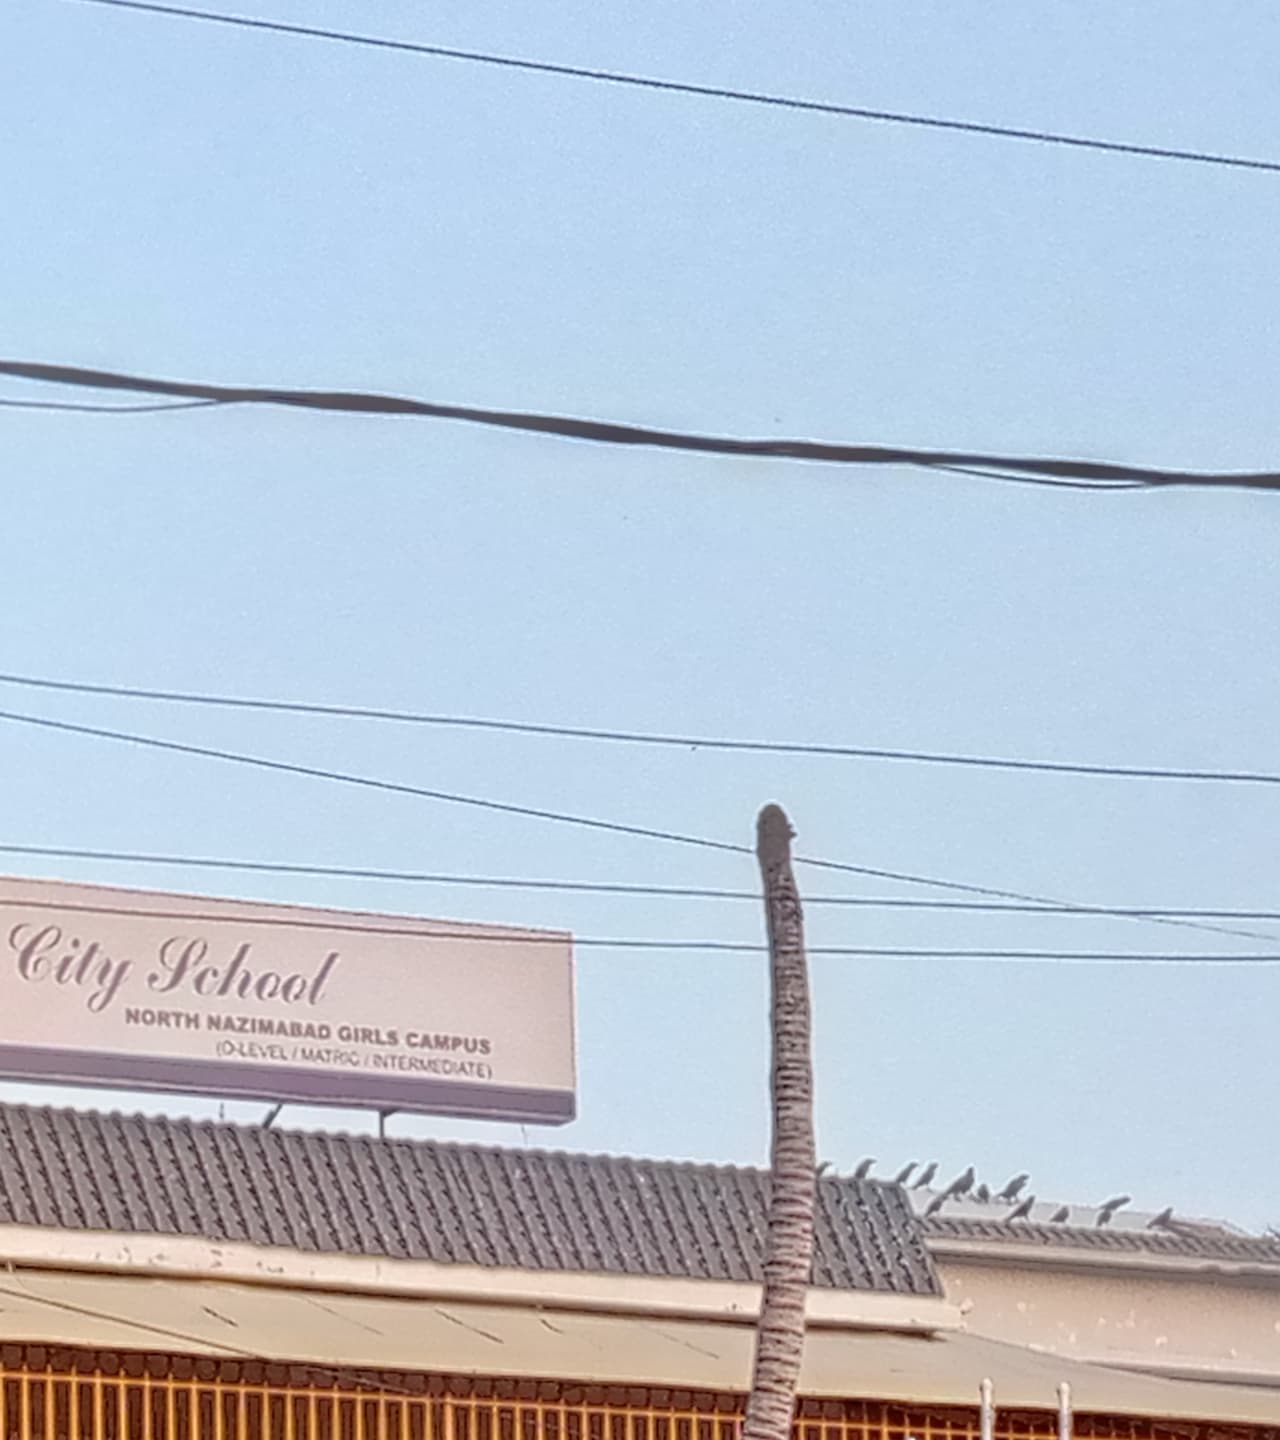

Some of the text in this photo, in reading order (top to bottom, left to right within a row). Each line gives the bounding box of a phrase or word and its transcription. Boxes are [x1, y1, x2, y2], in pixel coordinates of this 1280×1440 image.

[8, 922, 133, 1014] City
[147, 936, 339, 1006] School
[125, 1008, 491, 1055] NORTH NAZIMABAD GIRLS CAMPUS
